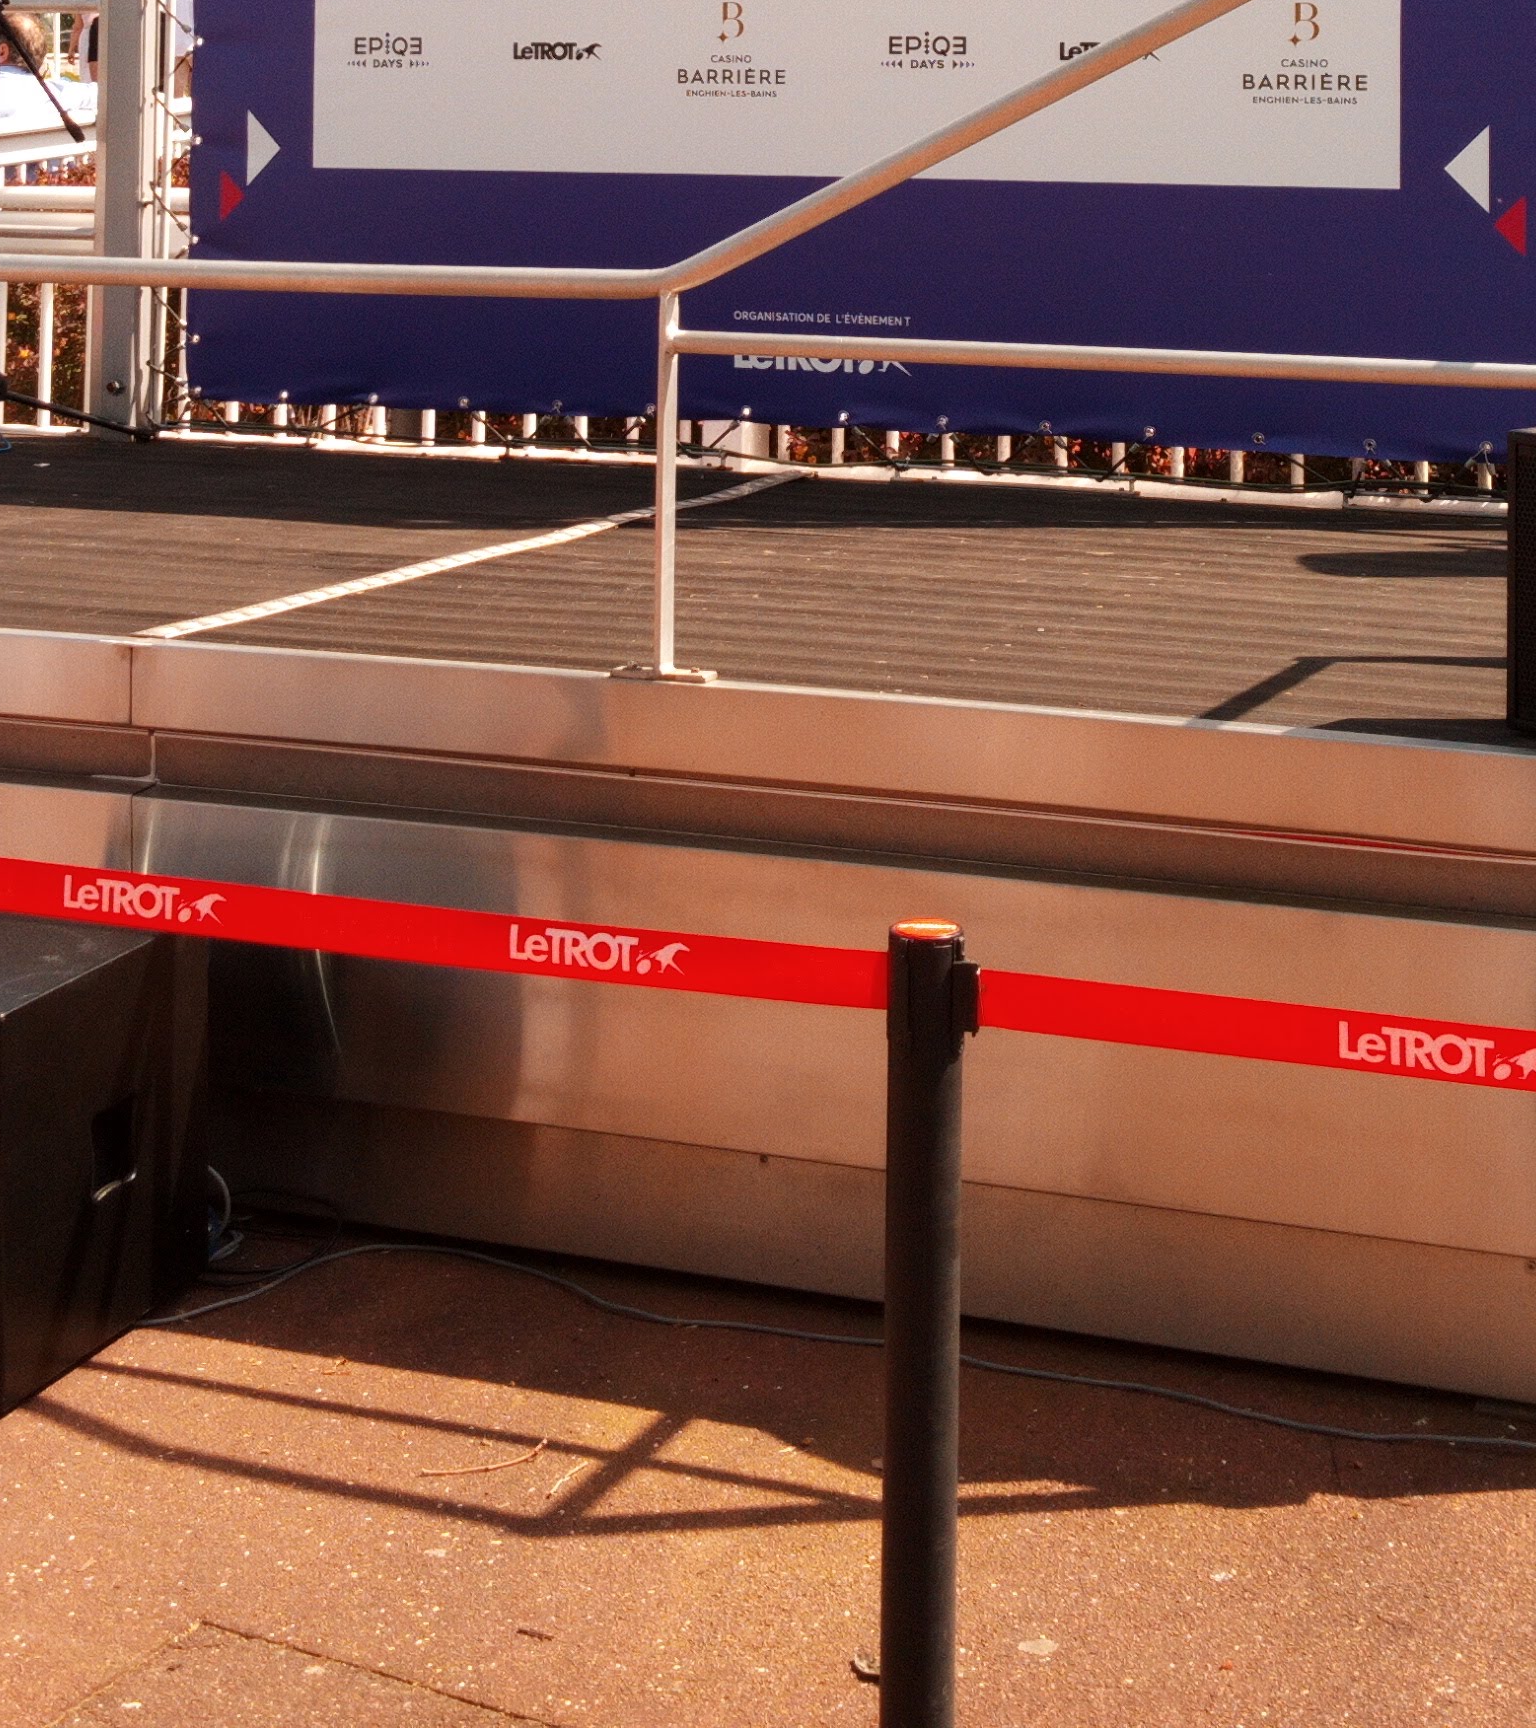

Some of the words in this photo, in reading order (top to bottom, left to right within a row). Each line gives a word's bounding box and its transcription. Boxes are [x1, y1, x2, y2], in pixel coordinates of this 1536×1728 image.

[512, 40, 576, 62] LeTROT
[372, 58, 404, 69] DAYS
[710, 54, 753, 64] CASINO
[909, 58, 945, 70] DAYS
[1280, 58, 1330, 68] CASINO
[676, 67, 786, 86] BARRIÈRE
[1241, 72, 1368, 92] BARRIÈRE
[685, 89, 779, 98] ENGHIEN-LES-BAINS
[1252, 96, 1359, 105] ENGHIEN-LES-BAINS
[733, 310, 814, 323] ORGANISATION
[816, 313, 831, 323] DE
[64, 874, 180, 920] LeTROT
[510, 924, 640, 974] LeTROT
[1338, 1022, 1496, 1077] LeTROT
